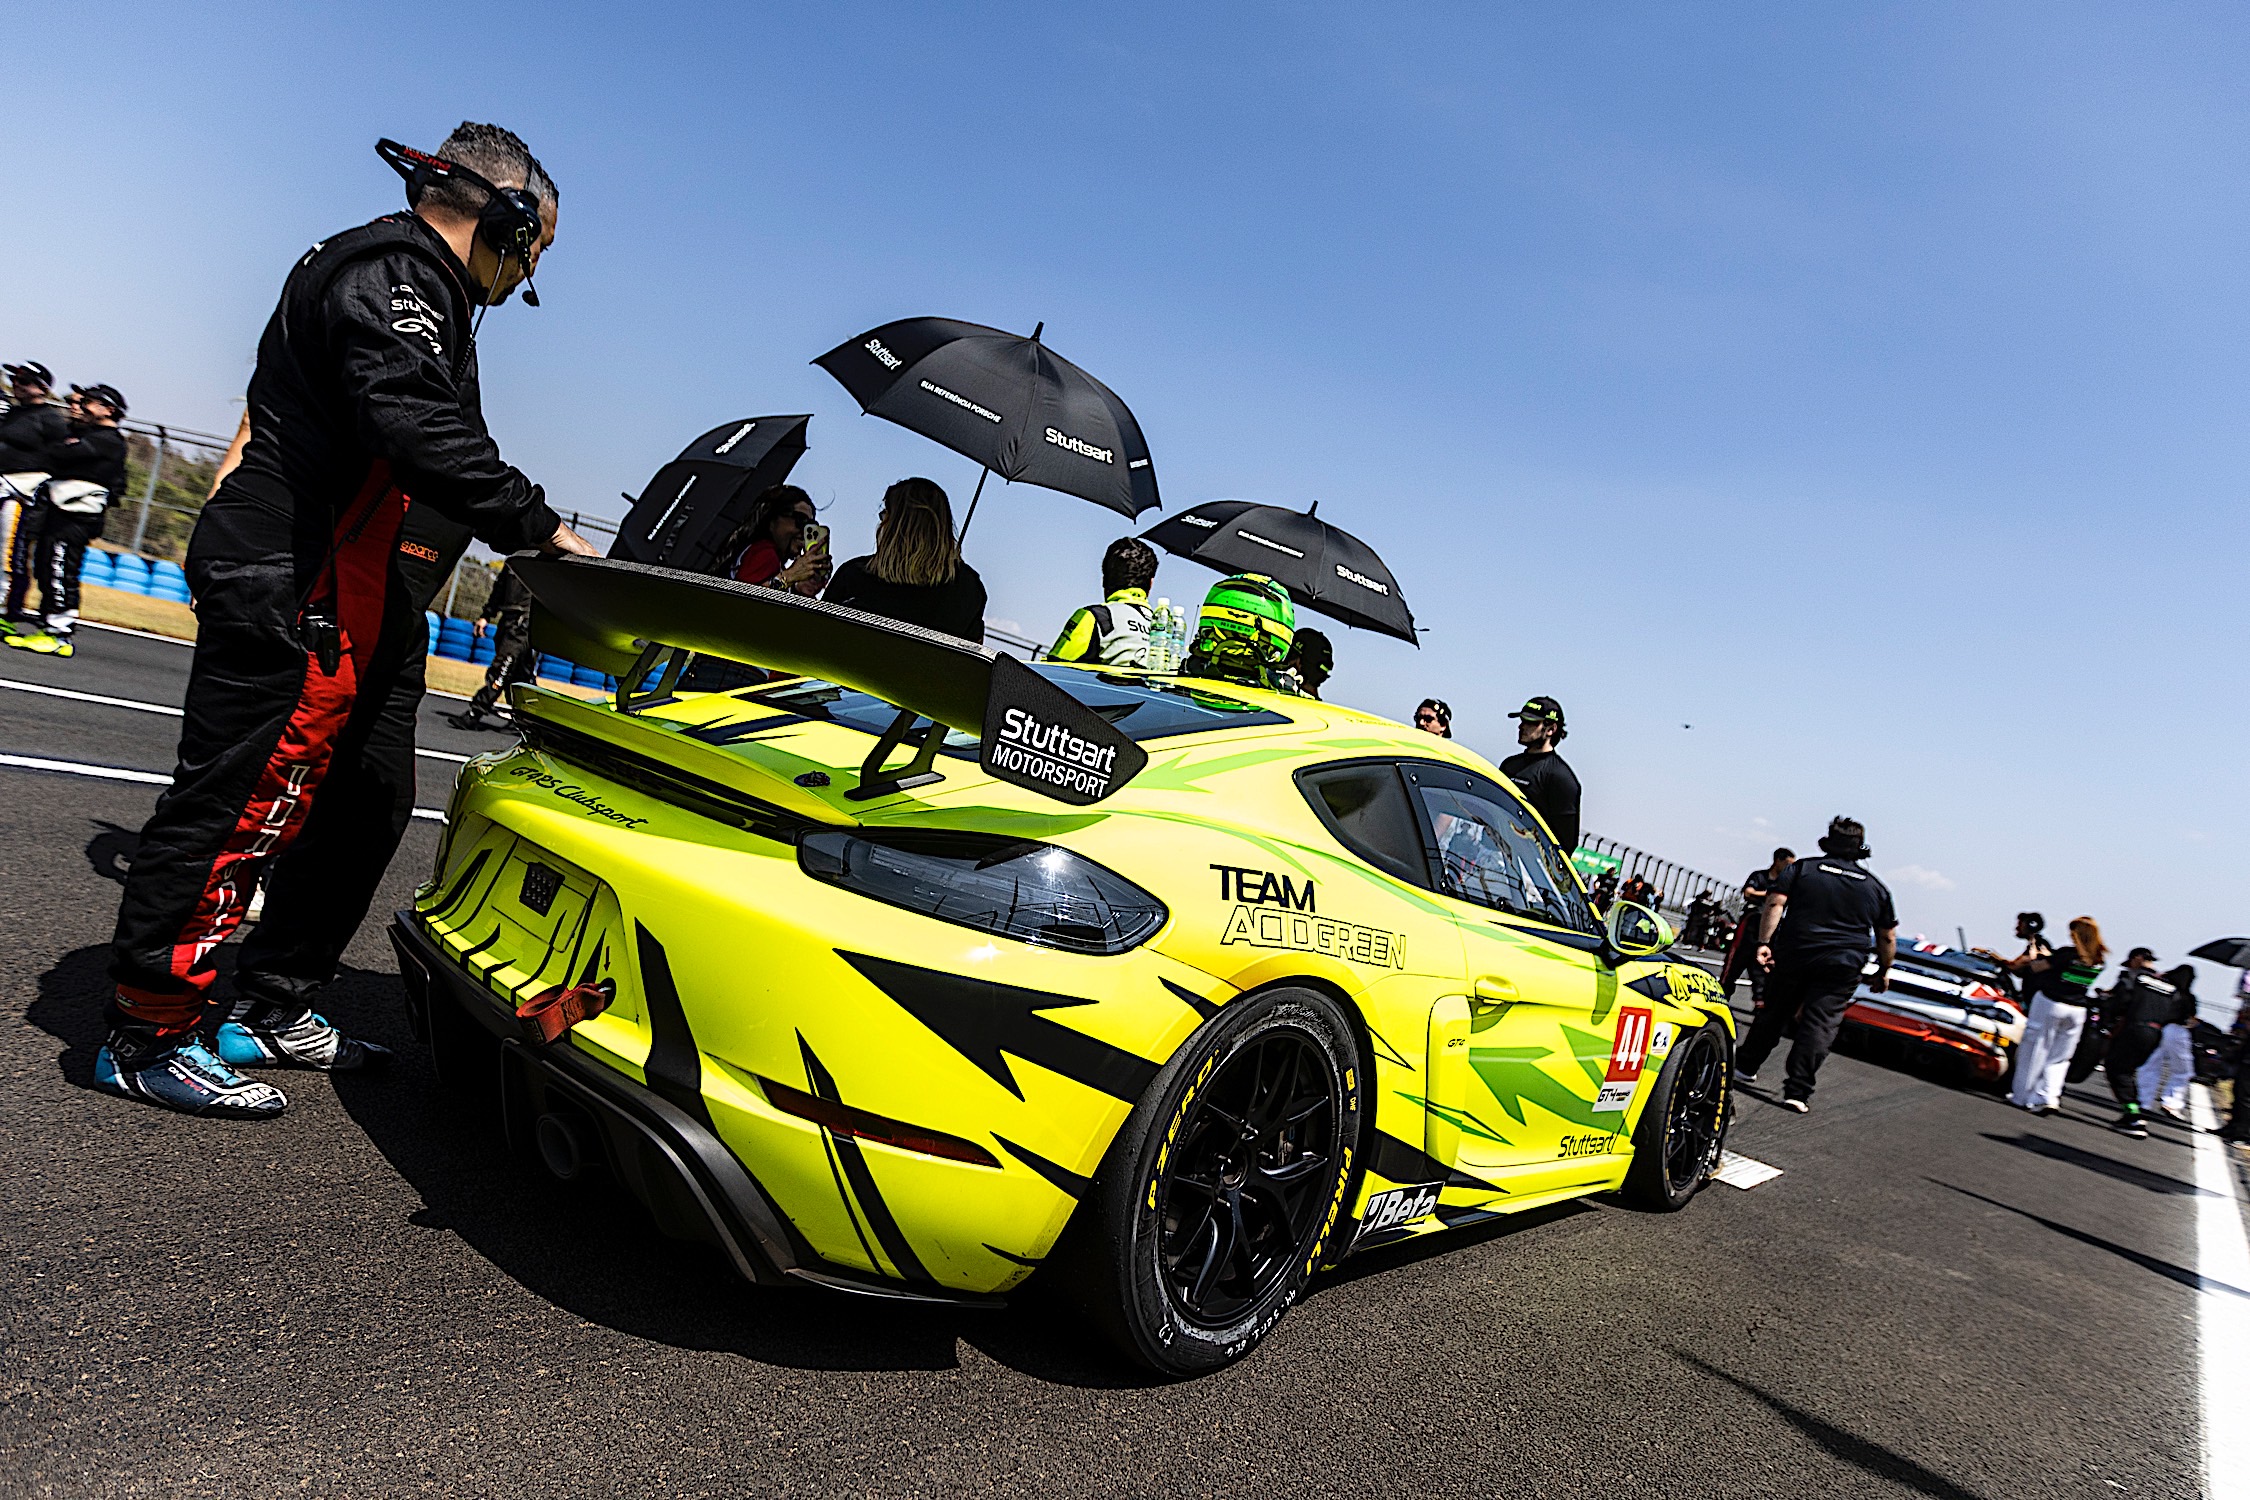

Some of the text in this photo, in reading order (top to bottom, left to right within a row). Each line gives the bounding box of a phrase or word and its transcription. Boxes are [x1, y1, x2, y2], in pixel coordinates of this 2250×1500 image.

[865, 338, 903, 371] Stuttgart
[971, 404, 1003, 424] PORSCHE
[1045, 427, 1113, 464] Stuttgart
[1336, 564, 1389, 596] Stuttgart
[1000, 708, 1116, 773] Stuttgart
[991, 744, 1108, 798] MOTORSPORT
[554, 785, 649, 829] Clubsport
[1209, 863, 1315, 913] TEAM
[1615, 1014, 1647, 1071] 44
[222, 1086, 273, 1108] OMP
[1558, 1131, 1615, 1158] Stuttgart
[1306, 1147, 1353, 1276] PIRELLI
[1374, 1187, 1437, 1231] Beta
